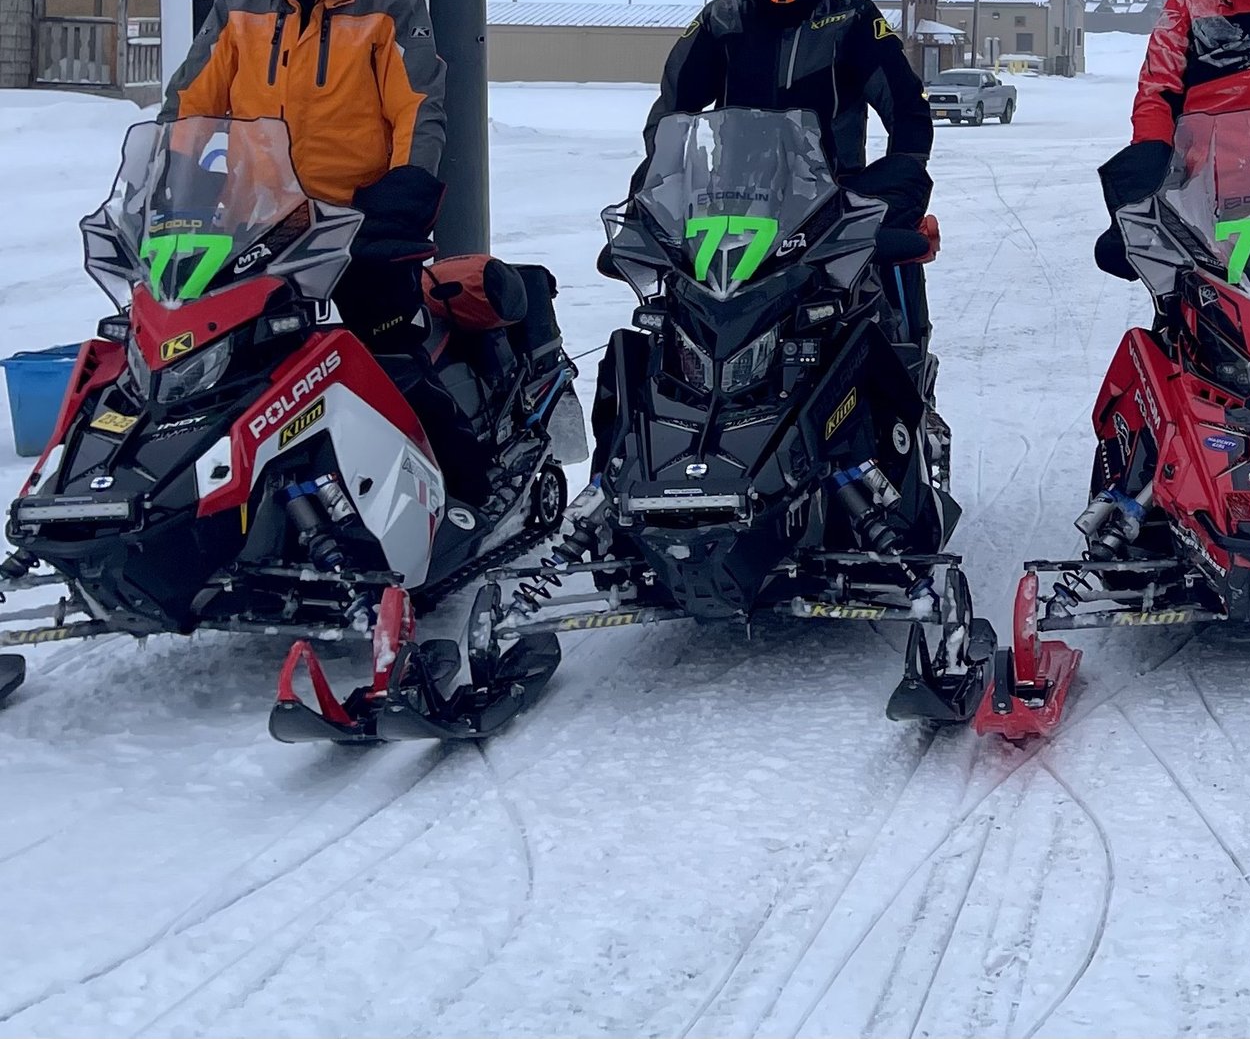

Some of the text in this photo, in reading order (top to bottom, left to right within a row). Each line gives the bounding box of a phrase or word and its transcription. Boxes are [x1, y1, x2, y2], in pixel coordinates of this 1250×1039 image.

[166, 219, 202, 229] GOLD
[239, 248, 272, 265] MTA
[685, 215, 779, 281] 77
[782, 237, 807, 250] MTA
[140, 234, 233, 301] 77
[248, 350, 341, 439] POLARIS
[157, 416, 207, 430] INDY
[281, 402, 322, 444] Klim
